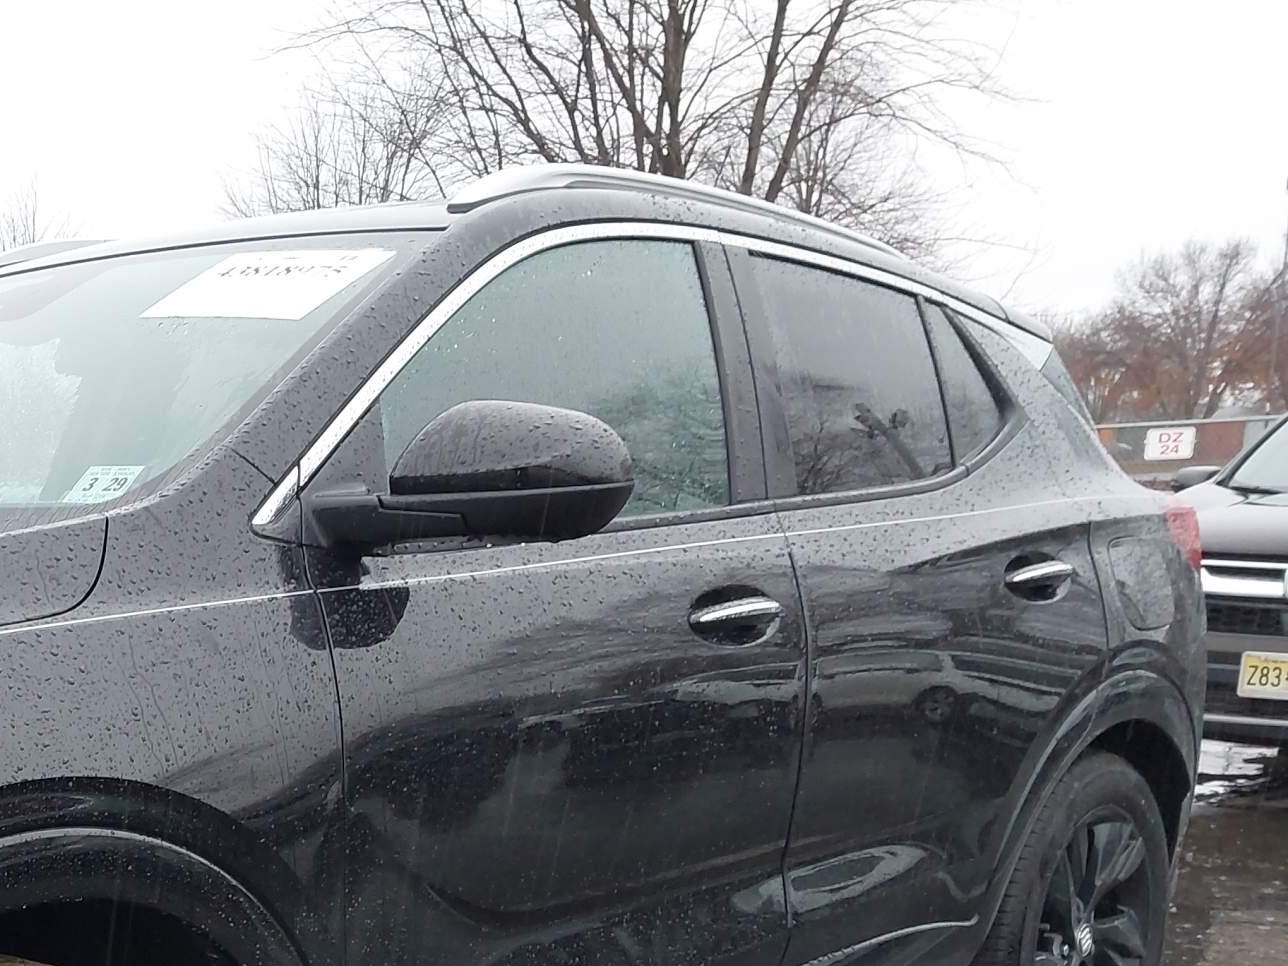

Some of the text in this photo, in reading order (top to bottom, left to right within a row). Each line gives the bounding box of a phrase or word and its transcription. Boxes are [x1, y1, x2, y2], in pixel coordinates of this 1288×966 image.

[1158, 432, 1184, 444] DZ
[1159, 444, 1179, 455] 24
[82, 477, 129, 492] 3 29
